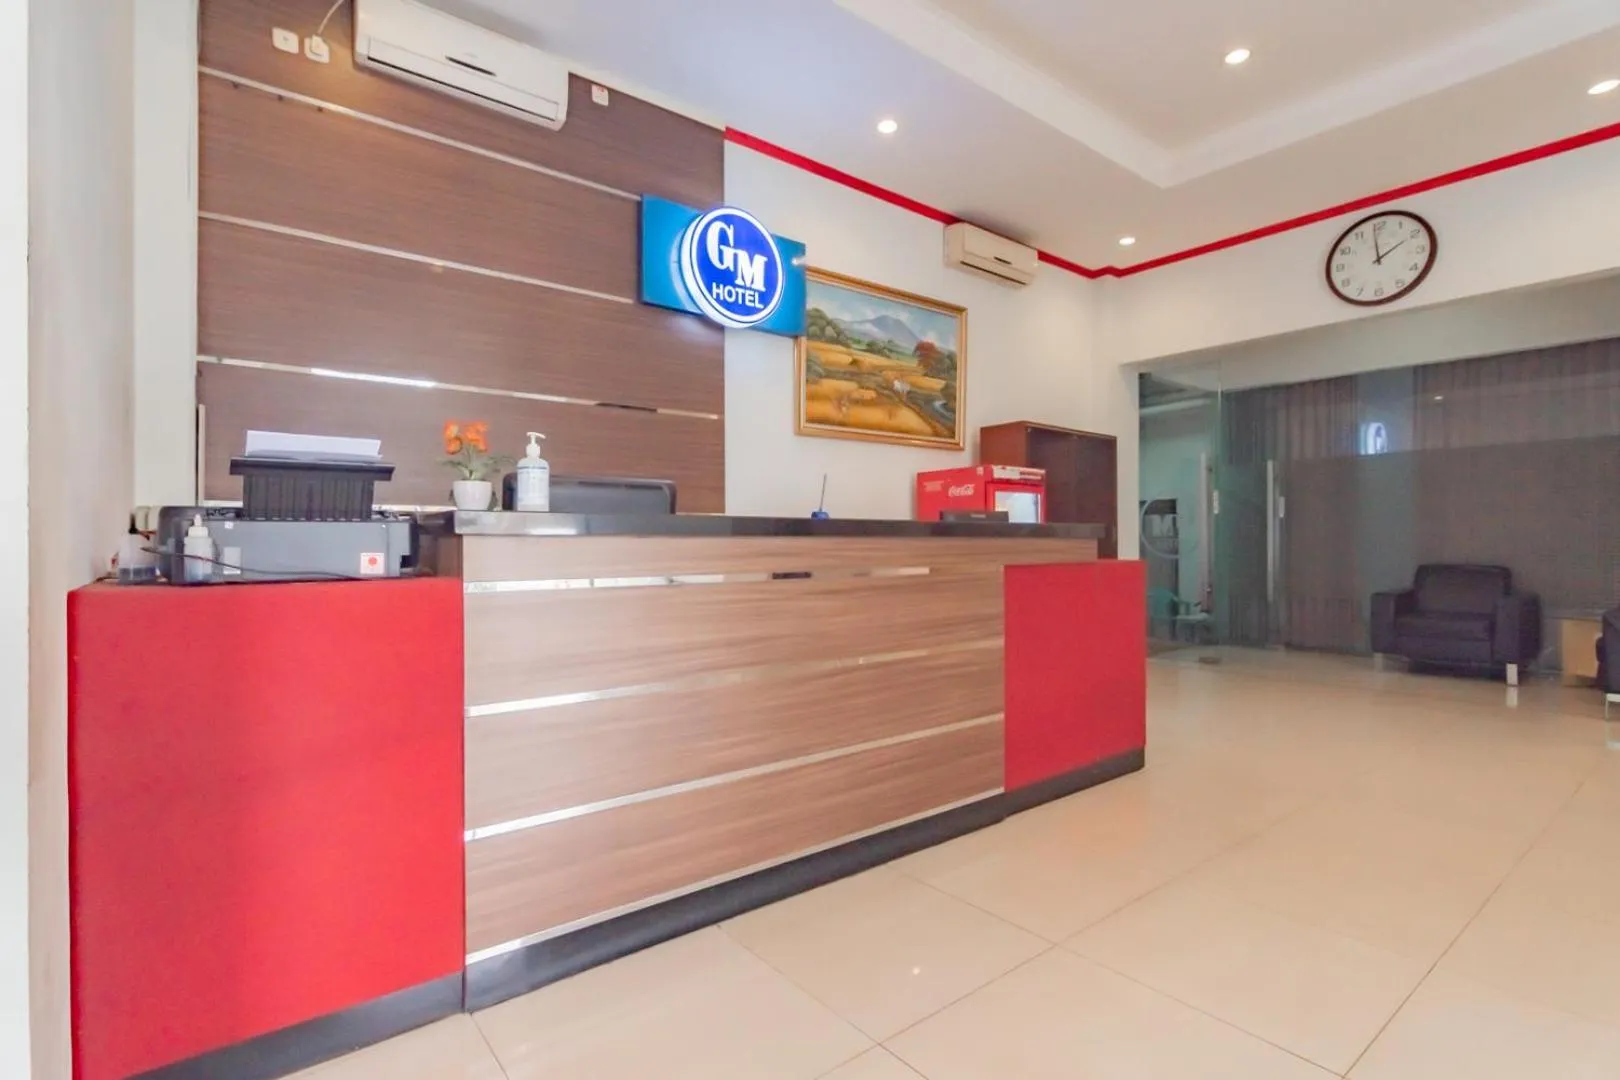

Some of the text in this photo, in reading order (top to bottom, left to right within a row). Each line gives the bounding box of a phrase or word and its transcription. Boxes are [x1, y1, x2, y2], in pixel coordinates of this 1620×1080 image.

[1354, 231, 1364, 240] 11
[1409, 228, 1421, 240] 2
[706, 221, 768, 292] GM
[1339, 246, 1351, 256] 10
[1408, 262, 1419, 271] 4
[711, 282, 765, 309] HOTEL
